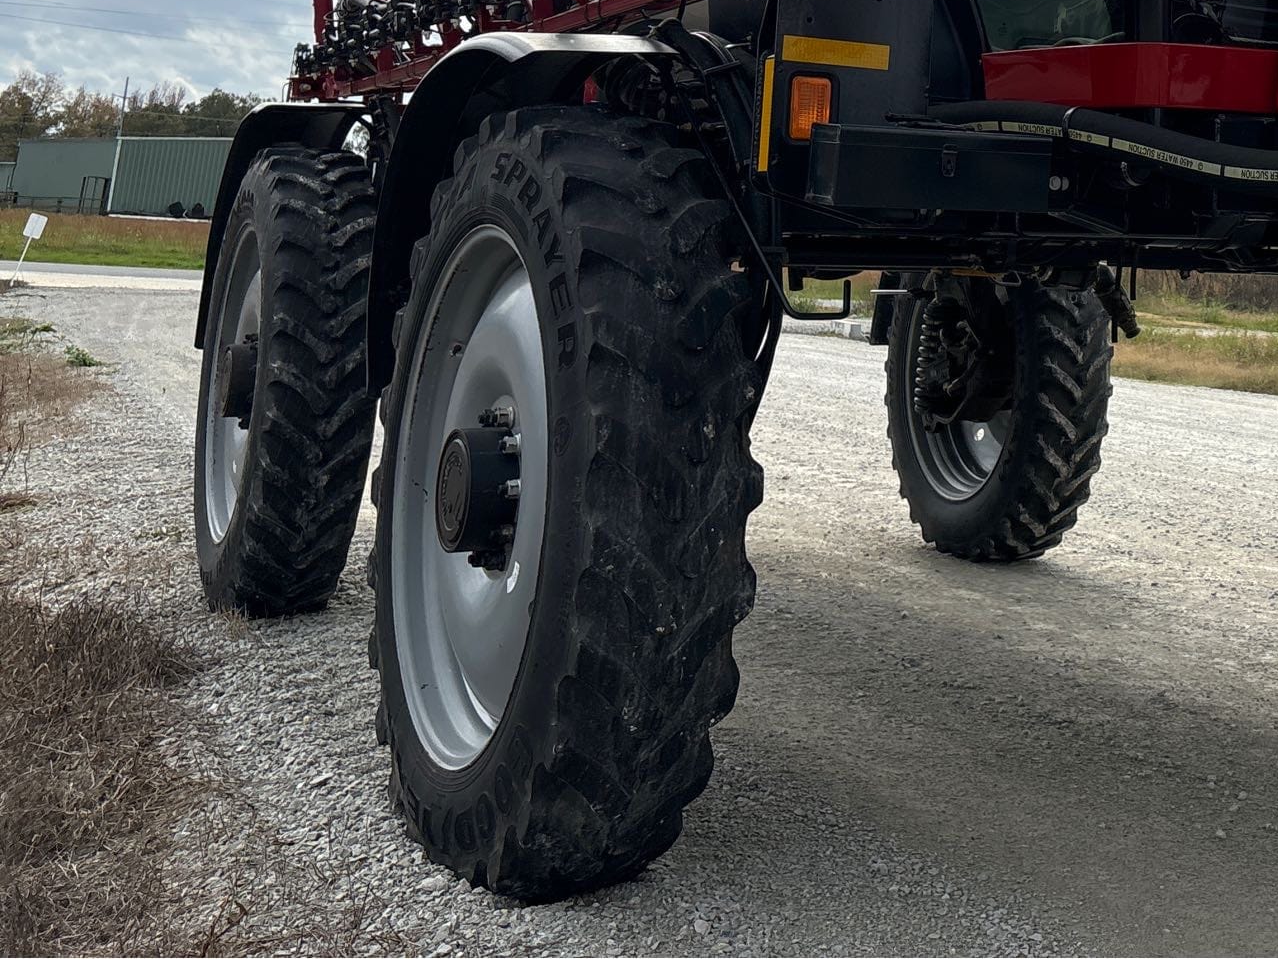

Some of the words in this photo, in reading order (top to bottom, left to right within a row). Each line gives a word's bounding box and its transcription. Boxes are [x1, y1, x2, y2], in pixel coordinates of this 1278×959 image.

[1018, 122, 1046, 133] SUCTION
[1046, 125, 1063, 136] ATER
[1128, 143, 1156, 158] SUCTION
[1157, 150, 1179, 164] WATER
[1180, 156, 1194, 168] 4450
[1240, 169, 1270, 180] SUCTION
[490, 151, 579, 371] SPRAYER
